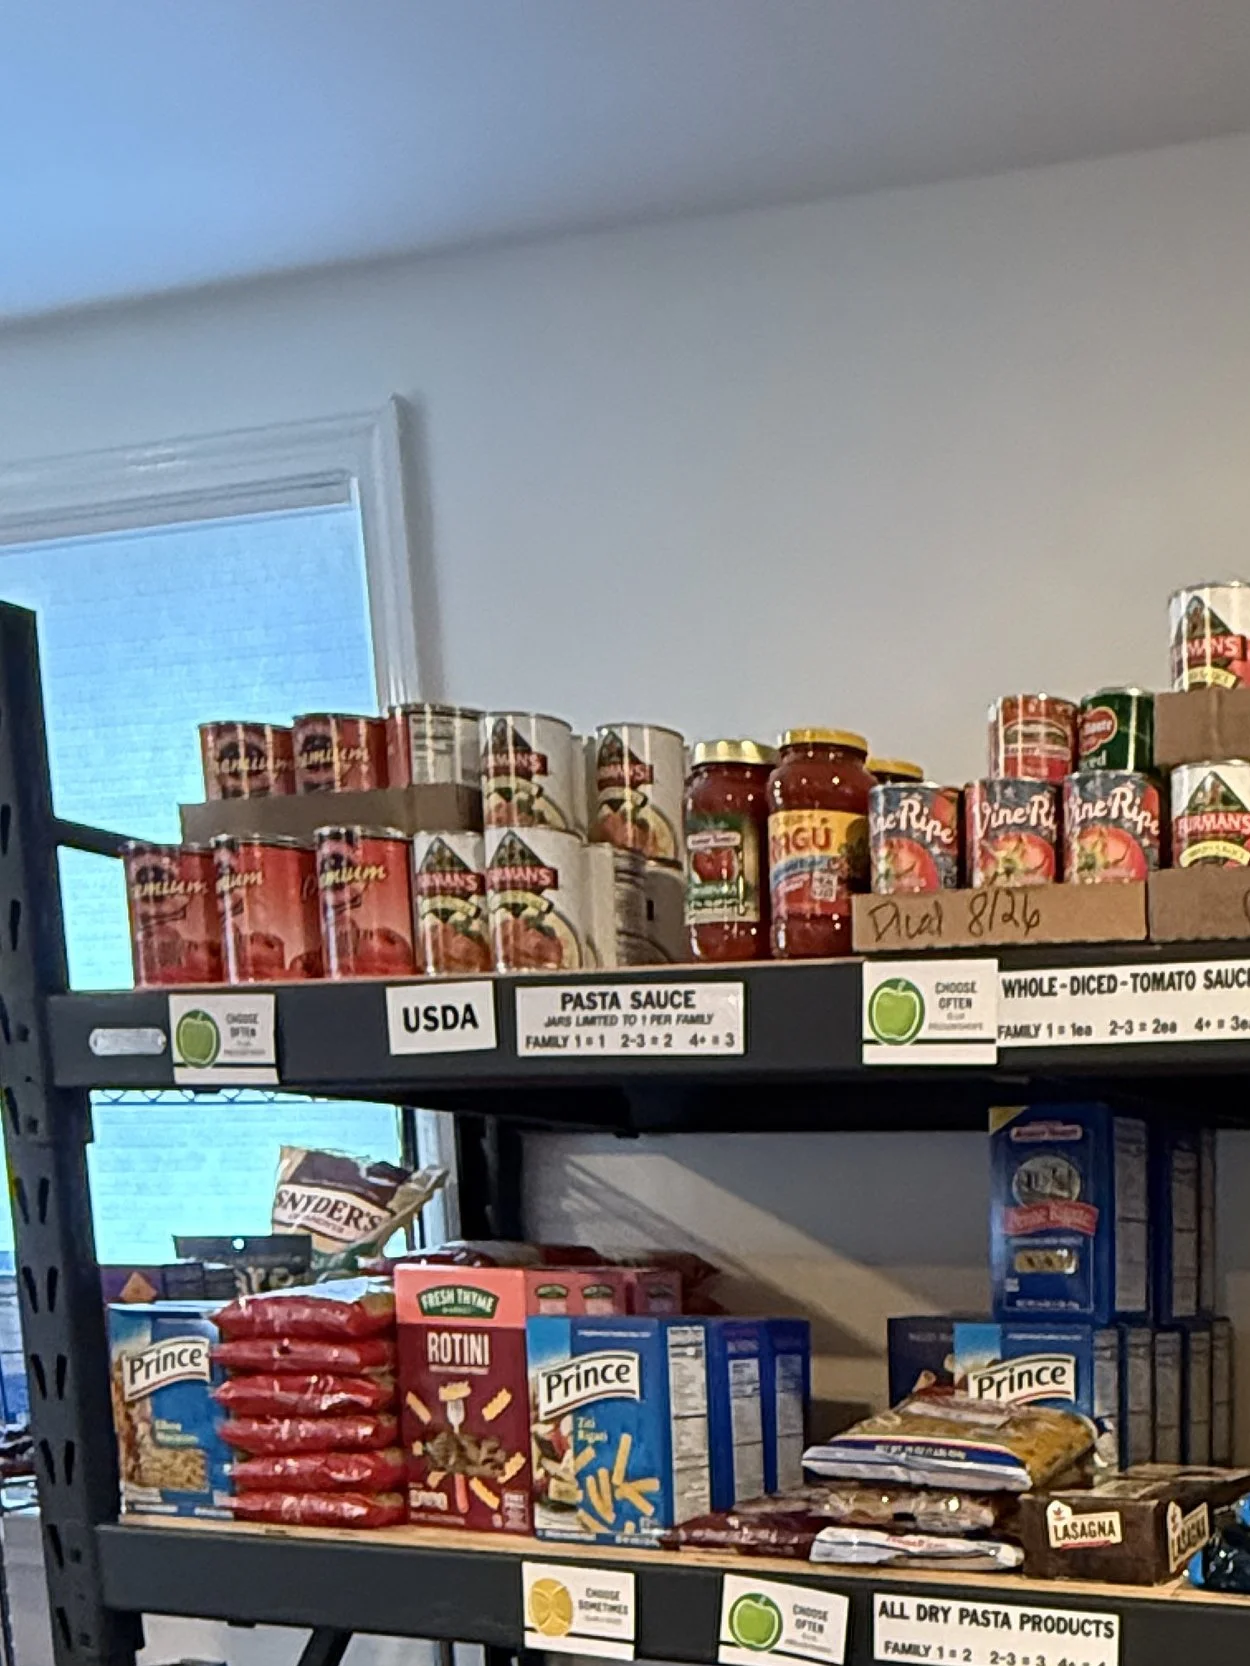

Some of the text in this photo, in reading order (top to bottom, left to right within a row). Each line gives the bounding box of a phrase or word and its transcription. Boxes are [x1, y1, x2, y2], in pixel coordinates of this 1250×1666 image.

[968, 886, 1041, 939] 8/26
[561, 990, 696, 1011] PASTA SAUCE
[935, 981, 977, 996] CHOOSE
[403, 1003, 479, 1034] USDA
[676, 1013, 714, 1026] FAMILY
[998, 1023, 1041, 1041] FAMILY
[1109, 1021, 1134, 1036] 2-3
[525, 1033, 735, 1050] FAMILY 2-3 2 3
[276, 1189, 382, 1233] SNYDER'S
[420, 1286, 495, 1313] FRESH THYME
[427, 1331, 490, 1366] ROTINI
[127, 1348, 203, 1385] Prince
[545, 1362, 631, 1403] Prince
[977, 1362, 1068, 1402] Prince
[1054, 1519, 1117, 1542] LASAGNA
[792, 1603, 829, 1622] CHOOSE
[879, 1600, 1115, 1640] ALL DRY PASTA PRODUCTS
[884, 1640, 932, 1658] FAMILY
[963, 1648, 972, 1662] 2
[990, 1650, 1016, 1666] 2-3
